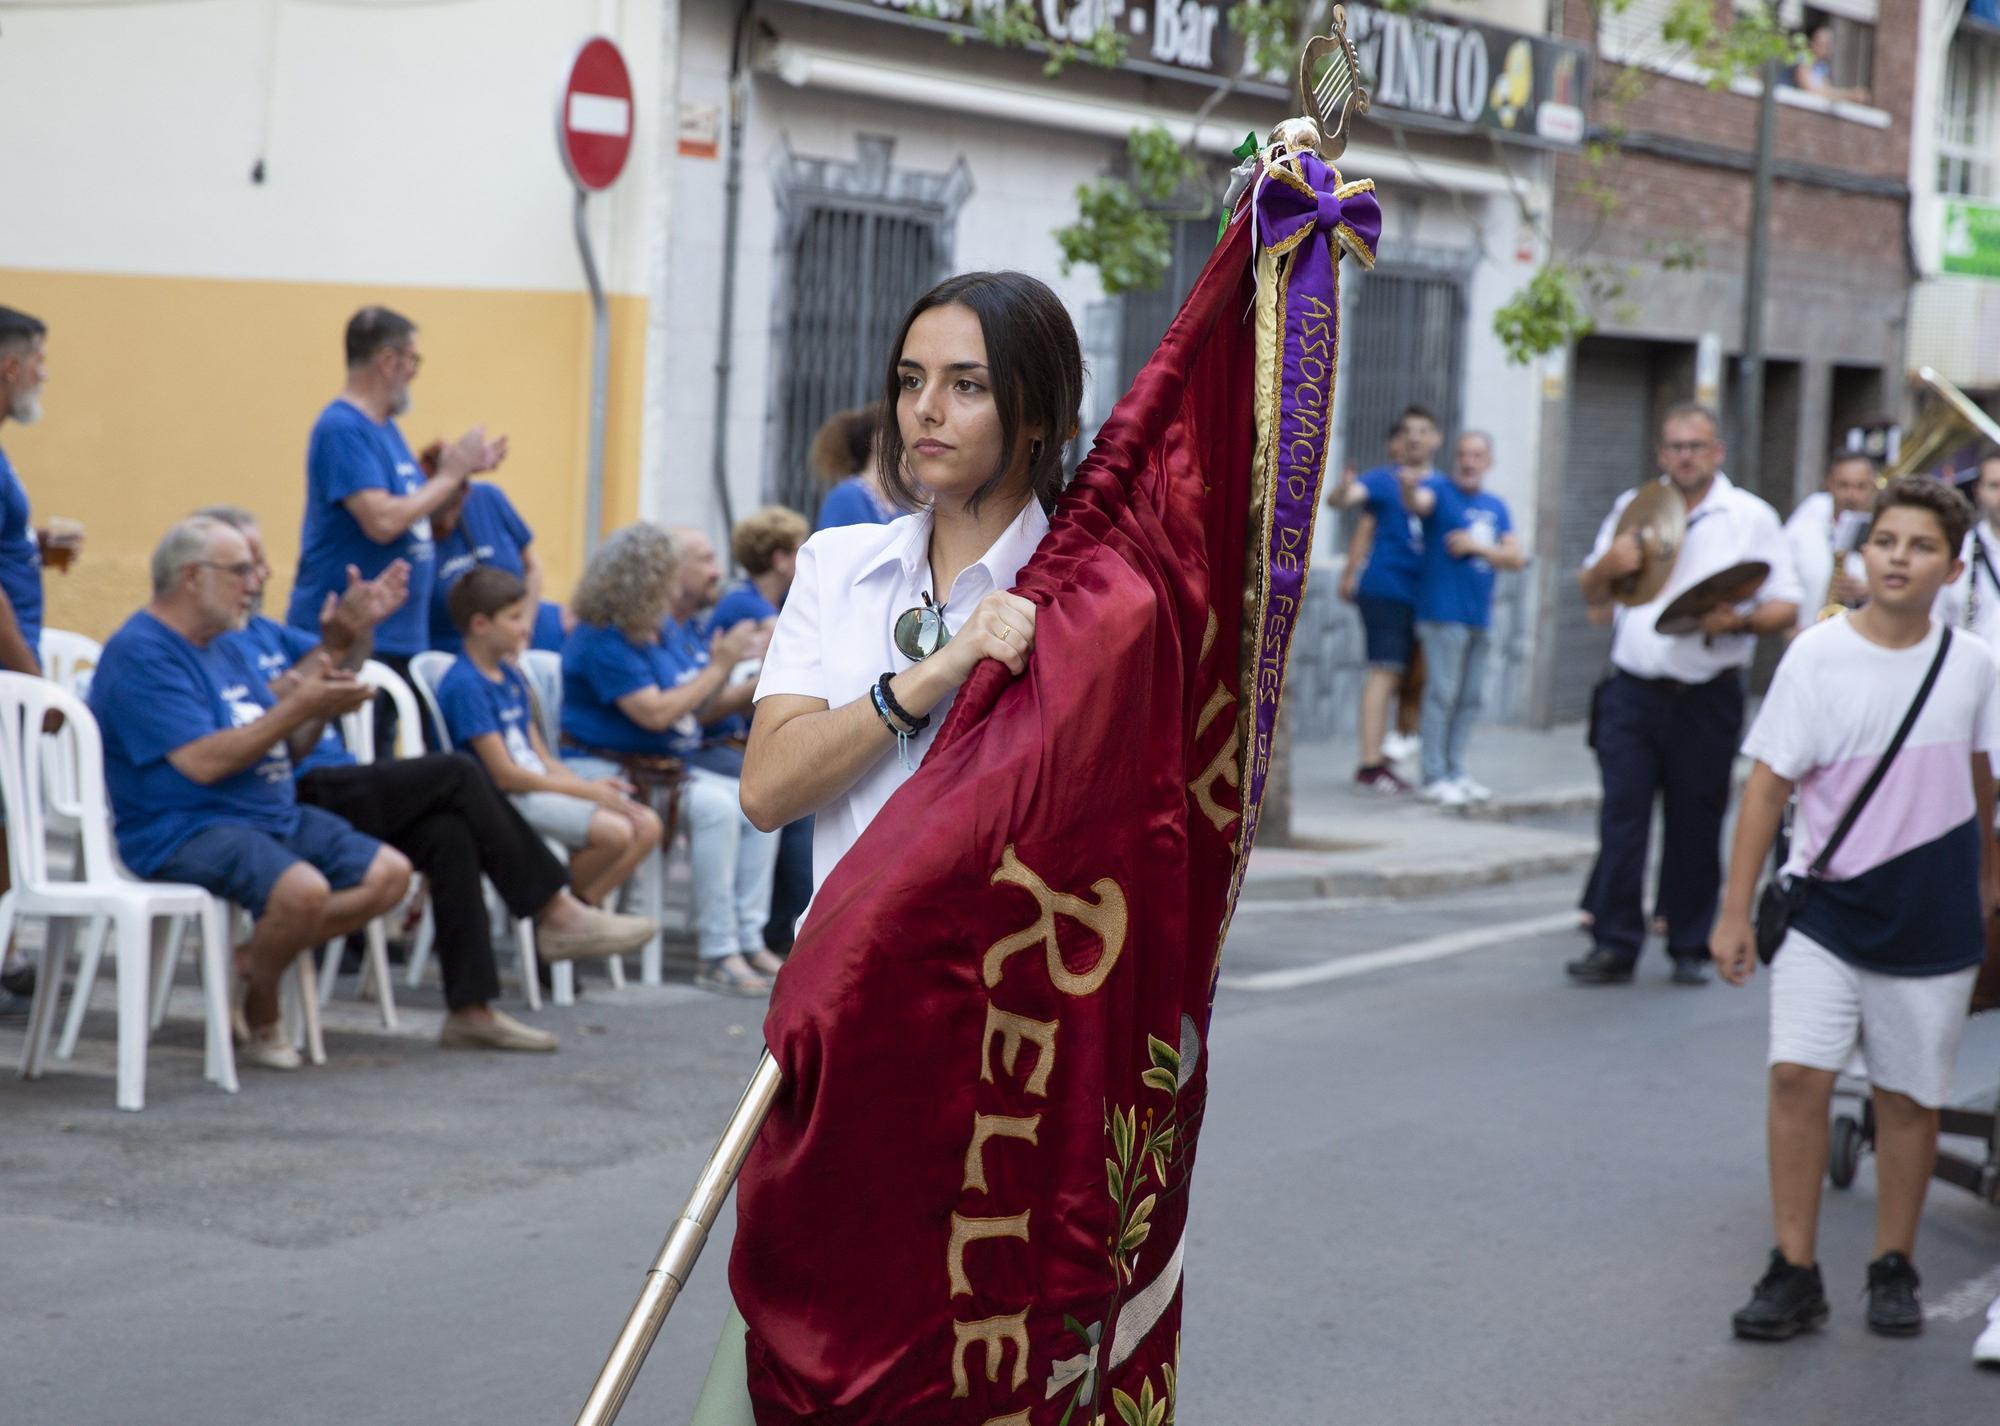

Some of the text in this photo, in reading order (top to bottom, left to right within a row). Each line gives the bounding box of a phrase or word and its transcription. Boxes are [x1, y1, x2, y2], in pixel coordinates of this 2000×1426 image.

[1152, 0, 1219, 70] Bar
[1276, 526, 1304, 573] DE
[1260, 594, 1294, 706] FESTES
[1256, 733, 1269, 778] DE
[946, 842, 1129, 1426] RELLE
